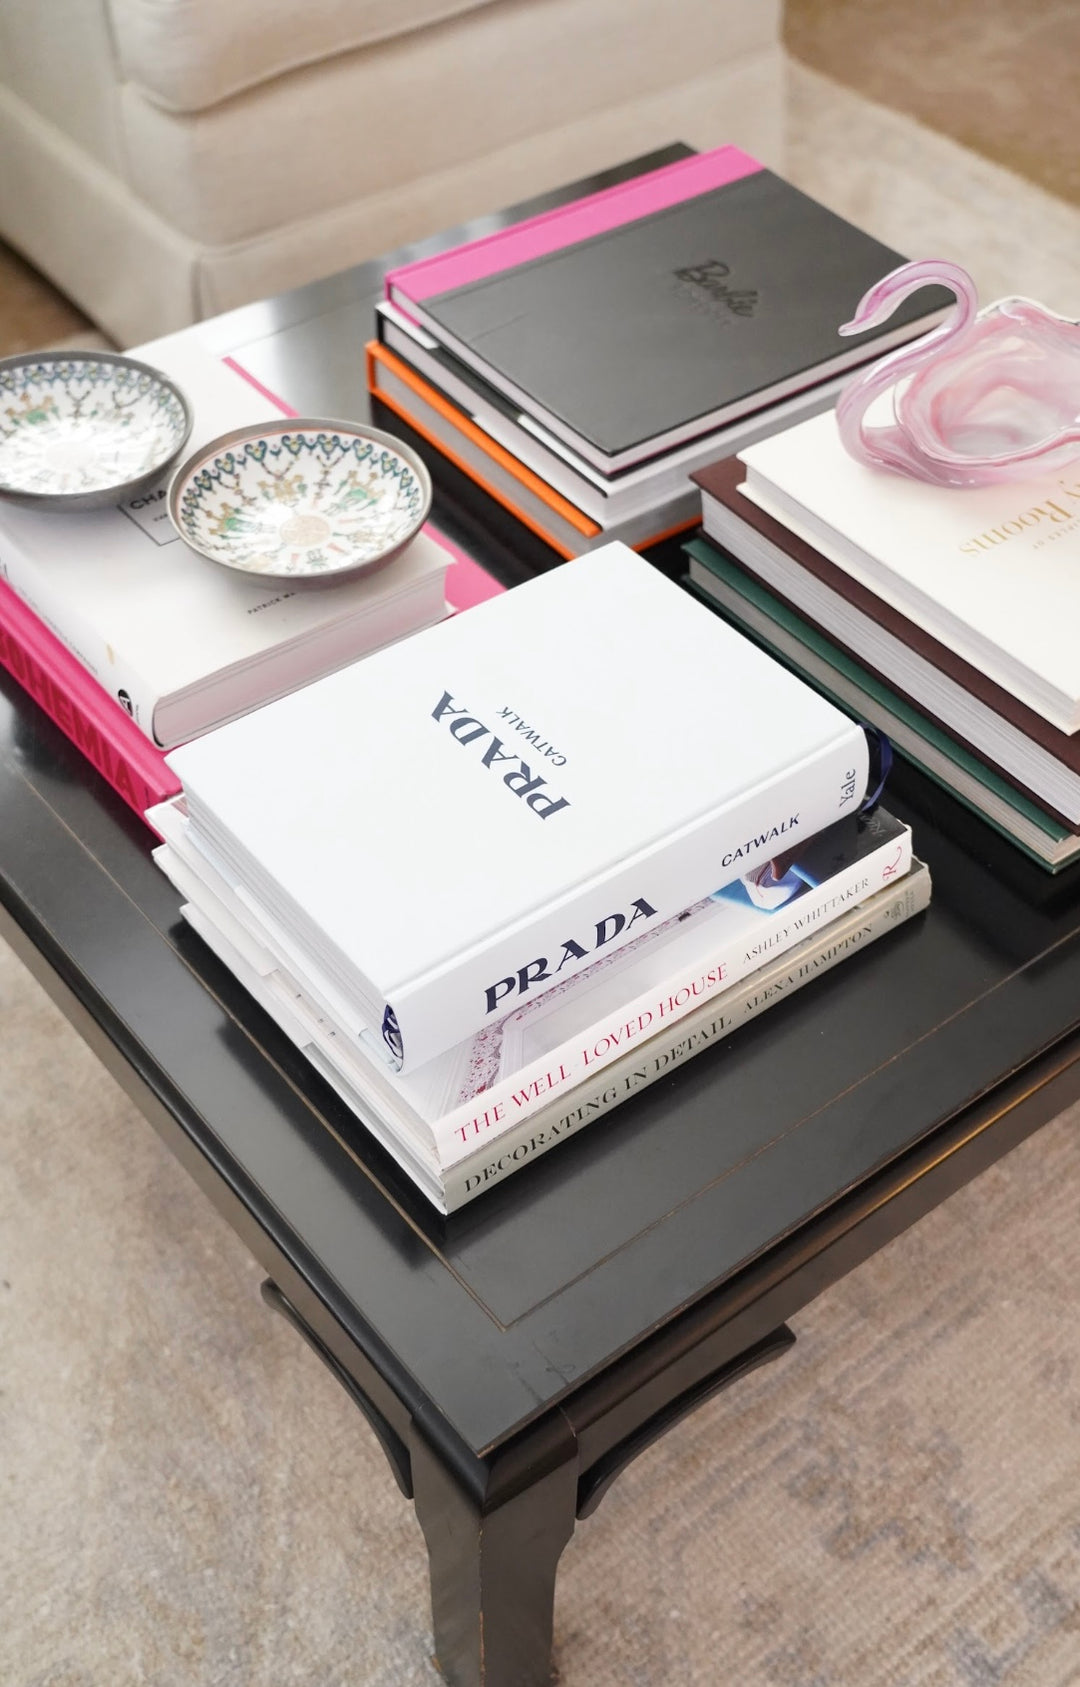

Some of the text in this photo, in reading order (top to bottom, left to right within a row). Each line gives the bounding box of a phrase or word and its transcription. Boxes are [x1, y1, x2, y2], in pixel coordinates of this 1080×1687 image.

[959, 501, 1072, 558] Rooms
[431, 689, 571, 820] PRADA
[496, 705, 568, 767] CATWALK
[840, 768, 857, 808] Yale
[484, 813, 800, 1015] PRADA CATWALK
[742, 930, 791, 964] ASHLEY
[794, 878, 870, 932] WHITTAKER
[455, 1103, 506, 1142] THE
[658, 962, 728, 1018] HOUSE
[464, 923, 875, 1192] DECORATING IN DETAIL ALEXA HAMPTON
